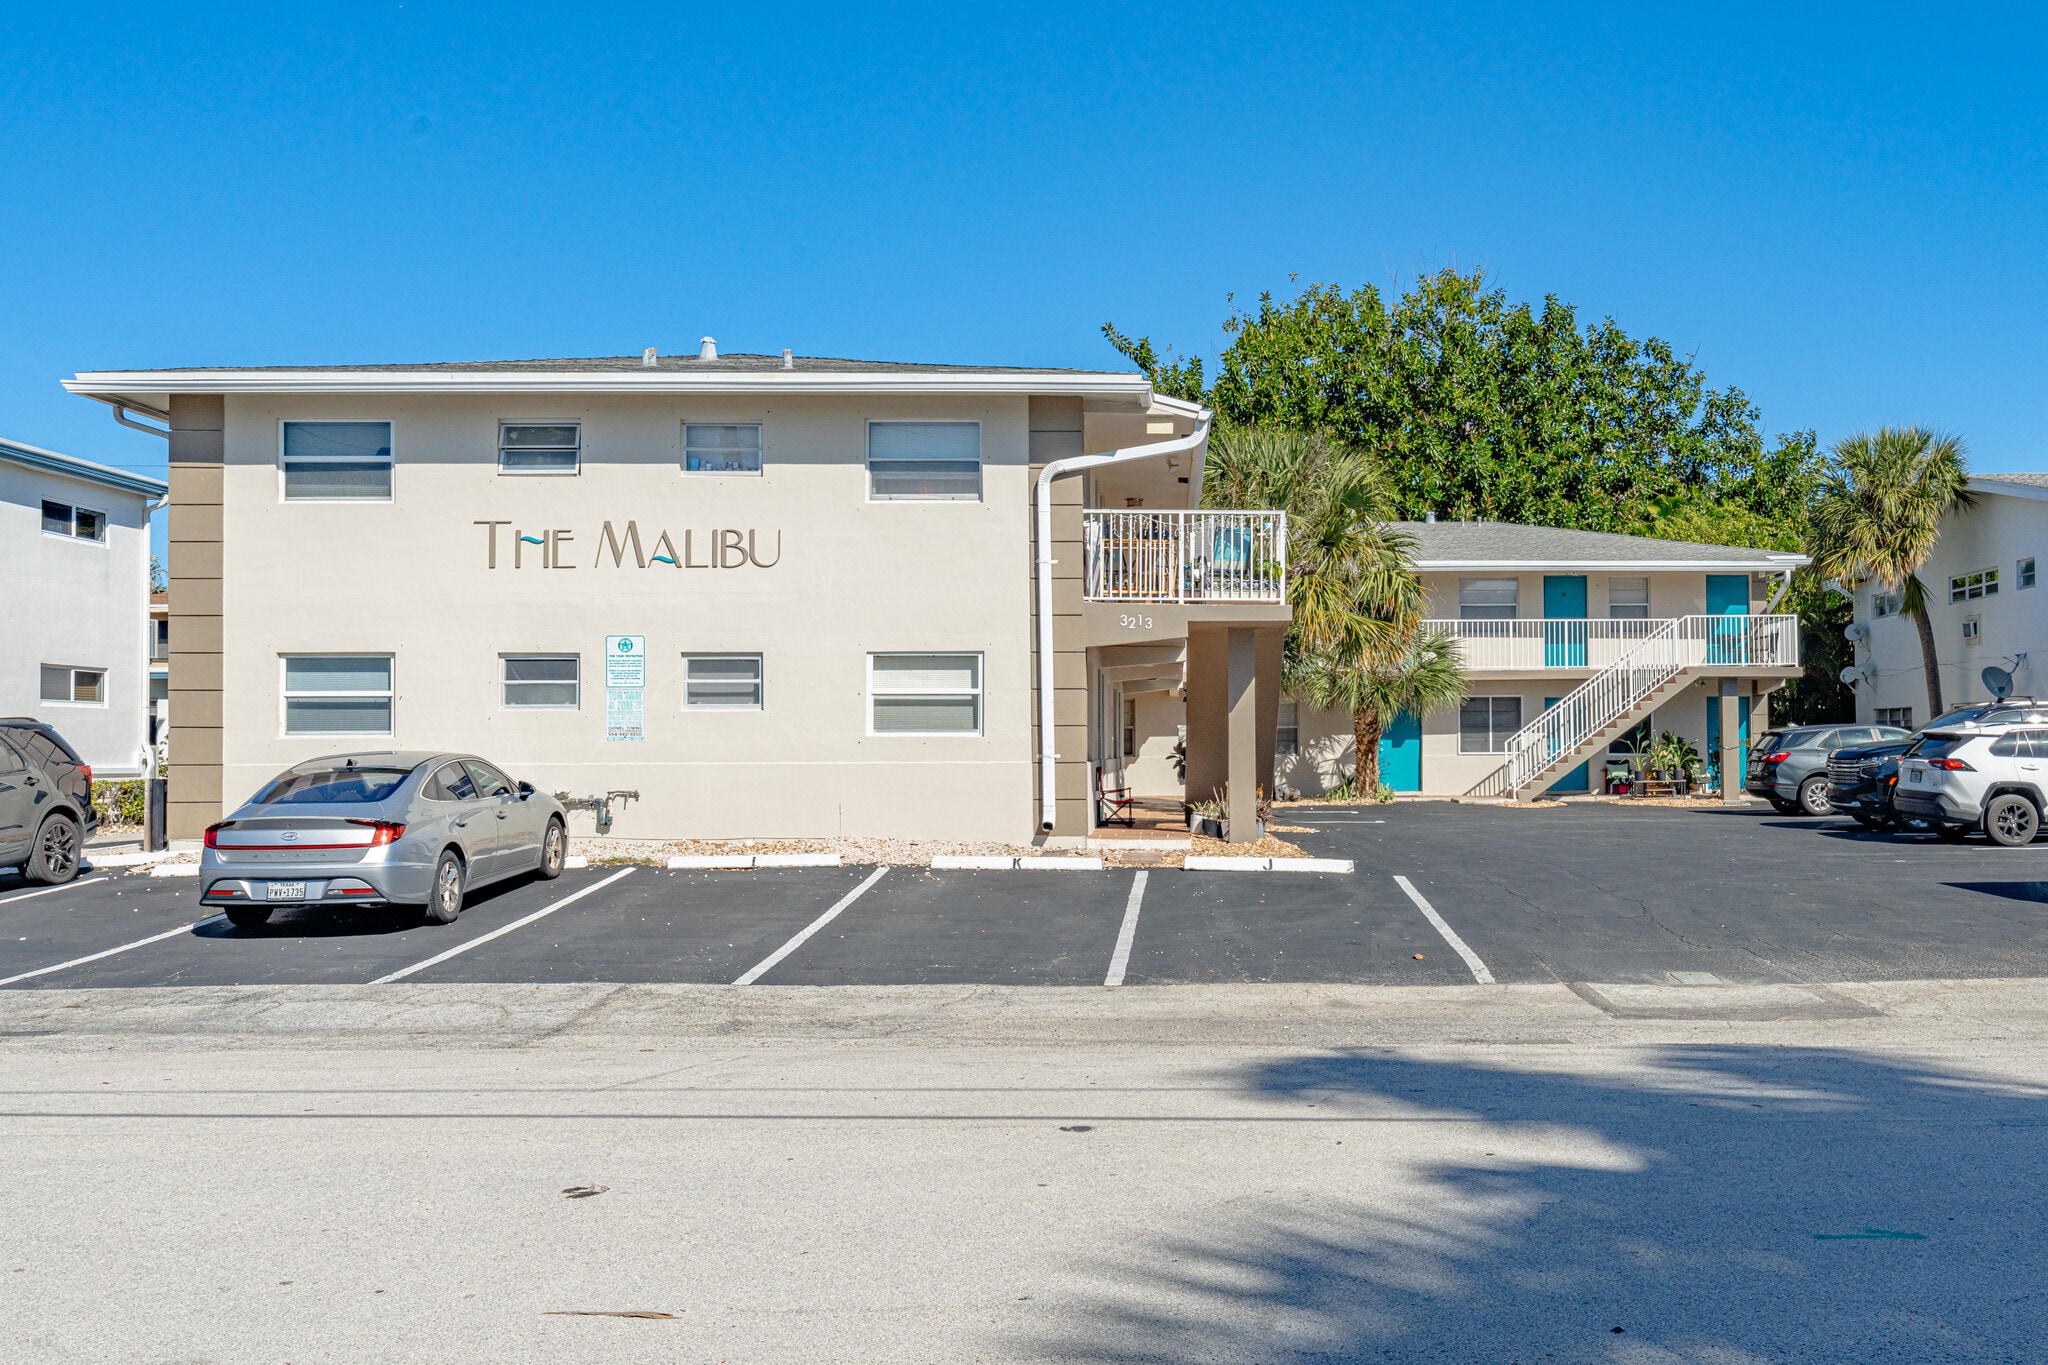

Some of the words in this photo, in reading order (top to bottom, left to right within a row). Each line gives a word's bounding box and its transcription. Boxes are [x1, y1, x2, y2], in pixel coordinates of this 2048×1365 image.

[473, 520, 576, 569] THE
[594, 520, 781, 569] MALIBU
[1119, 614, 1153, 629] 3213
[608, 690, 622, 700] TOW
[625, 690, 642, 700] AWAY
[617, 700, 634, 710] ZONE
[1012, 857, 1022, 870] K
[1262, 858, 1273, 870] J
